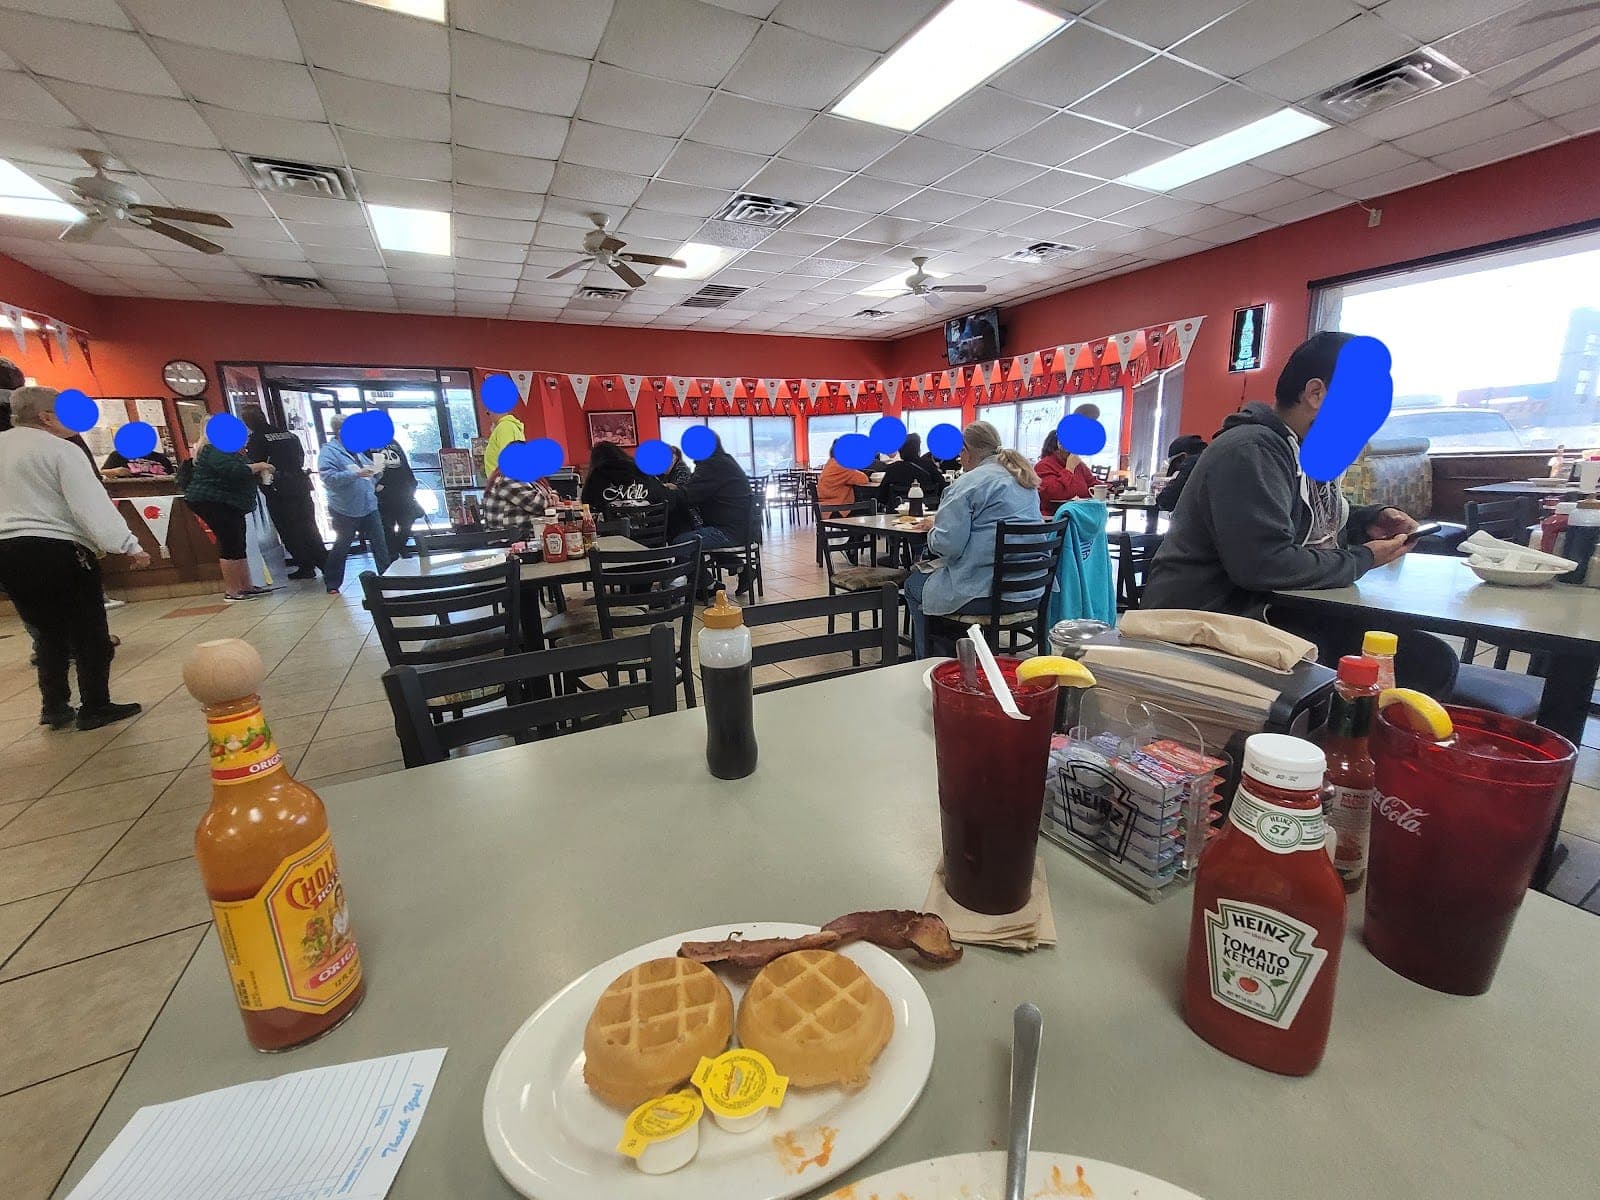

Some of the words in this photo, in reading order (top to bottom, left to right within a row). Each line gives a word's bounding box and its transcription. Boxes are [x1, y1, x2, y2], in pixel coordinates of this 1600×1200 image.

[1071, 787, 1124, 827] HEINZ
[1270, 815, 1293, 826] HEINZ
[1269, 824, 1290, 836] 57
[1232, 913, 1291, 943] HEINZ
[1222, 932, 1290, 969] TOMATO
[1223, 947, 1286, 977] KETCHUP
[381, 1118, 411, 1158] Thank
[403, 1083, 424, 1113] You!
